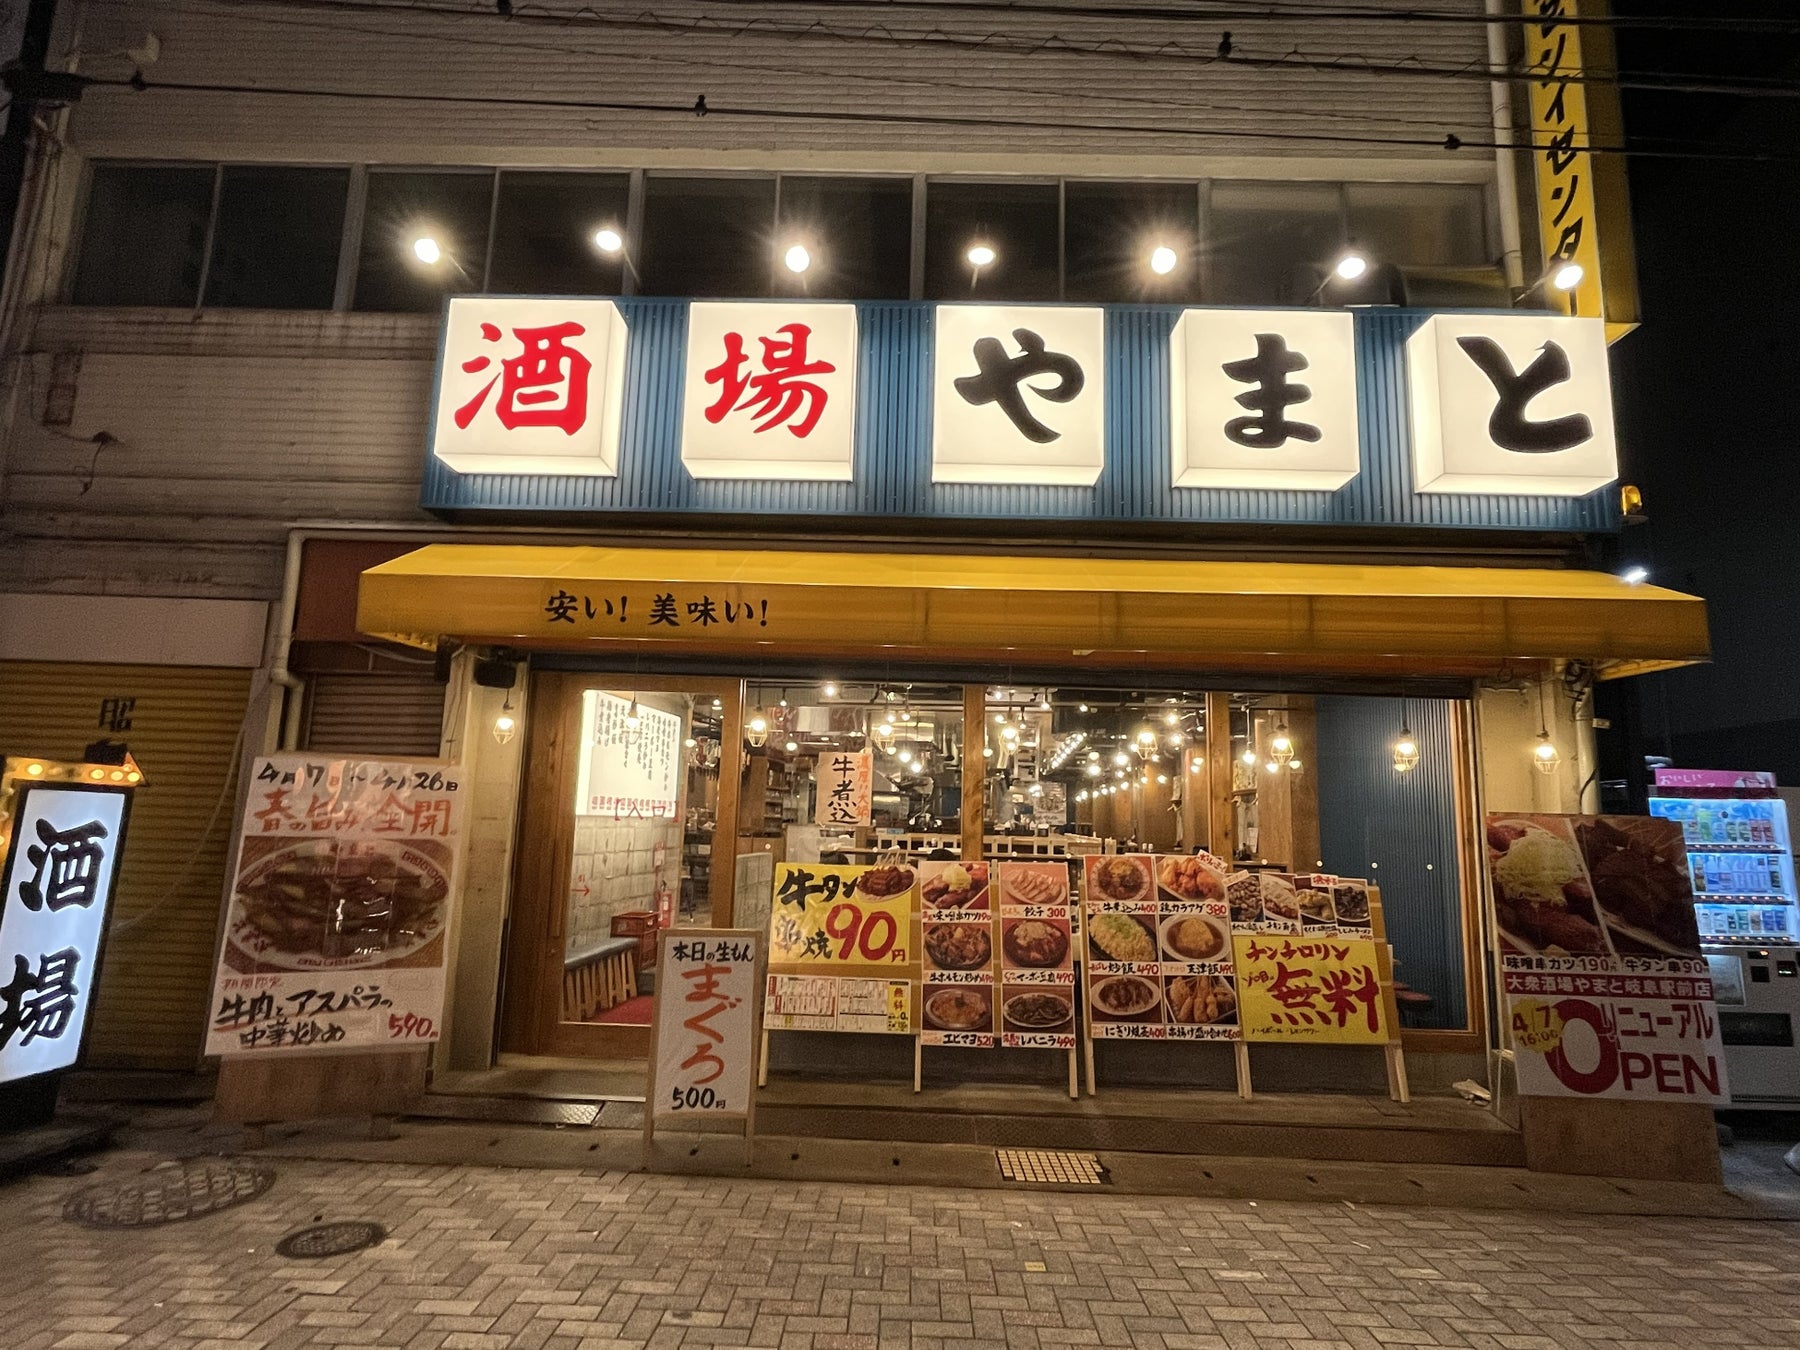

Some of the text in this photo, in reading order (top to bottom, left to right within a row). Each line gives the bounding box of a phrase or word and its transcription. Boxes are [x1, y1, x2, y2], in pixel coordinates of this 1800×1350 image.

[827, 755, 860, 825] 牛煮込
[776, 868, 859, 911] 牛タン
[1023, 906, 1045, 917] 餃子
[1047, 908, 1066, 918] 300
[1206, 904, 1227, 915] 380
[0, 819, 108, 1051] 酒場
[825, 903, 906, 963] 90円
[1055, 972, 1075, 984] 490
[1108, 962, 1135, 974] 炒飯
[1136, 963, 1159, 975] 490
[1267, 962, 1380, 1034] 無料
[1507, 974, 1712, 999] 大衆酒場やまと岐阜駅前店
[680, 963, 742, 1085] まぐろ
[943, 1034, 977, 1045] エビマヨ
[1021, 1034, 1057, 1046] レバニラ
[1056, 1036, 1075, 1048] 490
[1544, 999, 1722, 1096] OPEN
[672, 1086, 726, 1111] 500円
